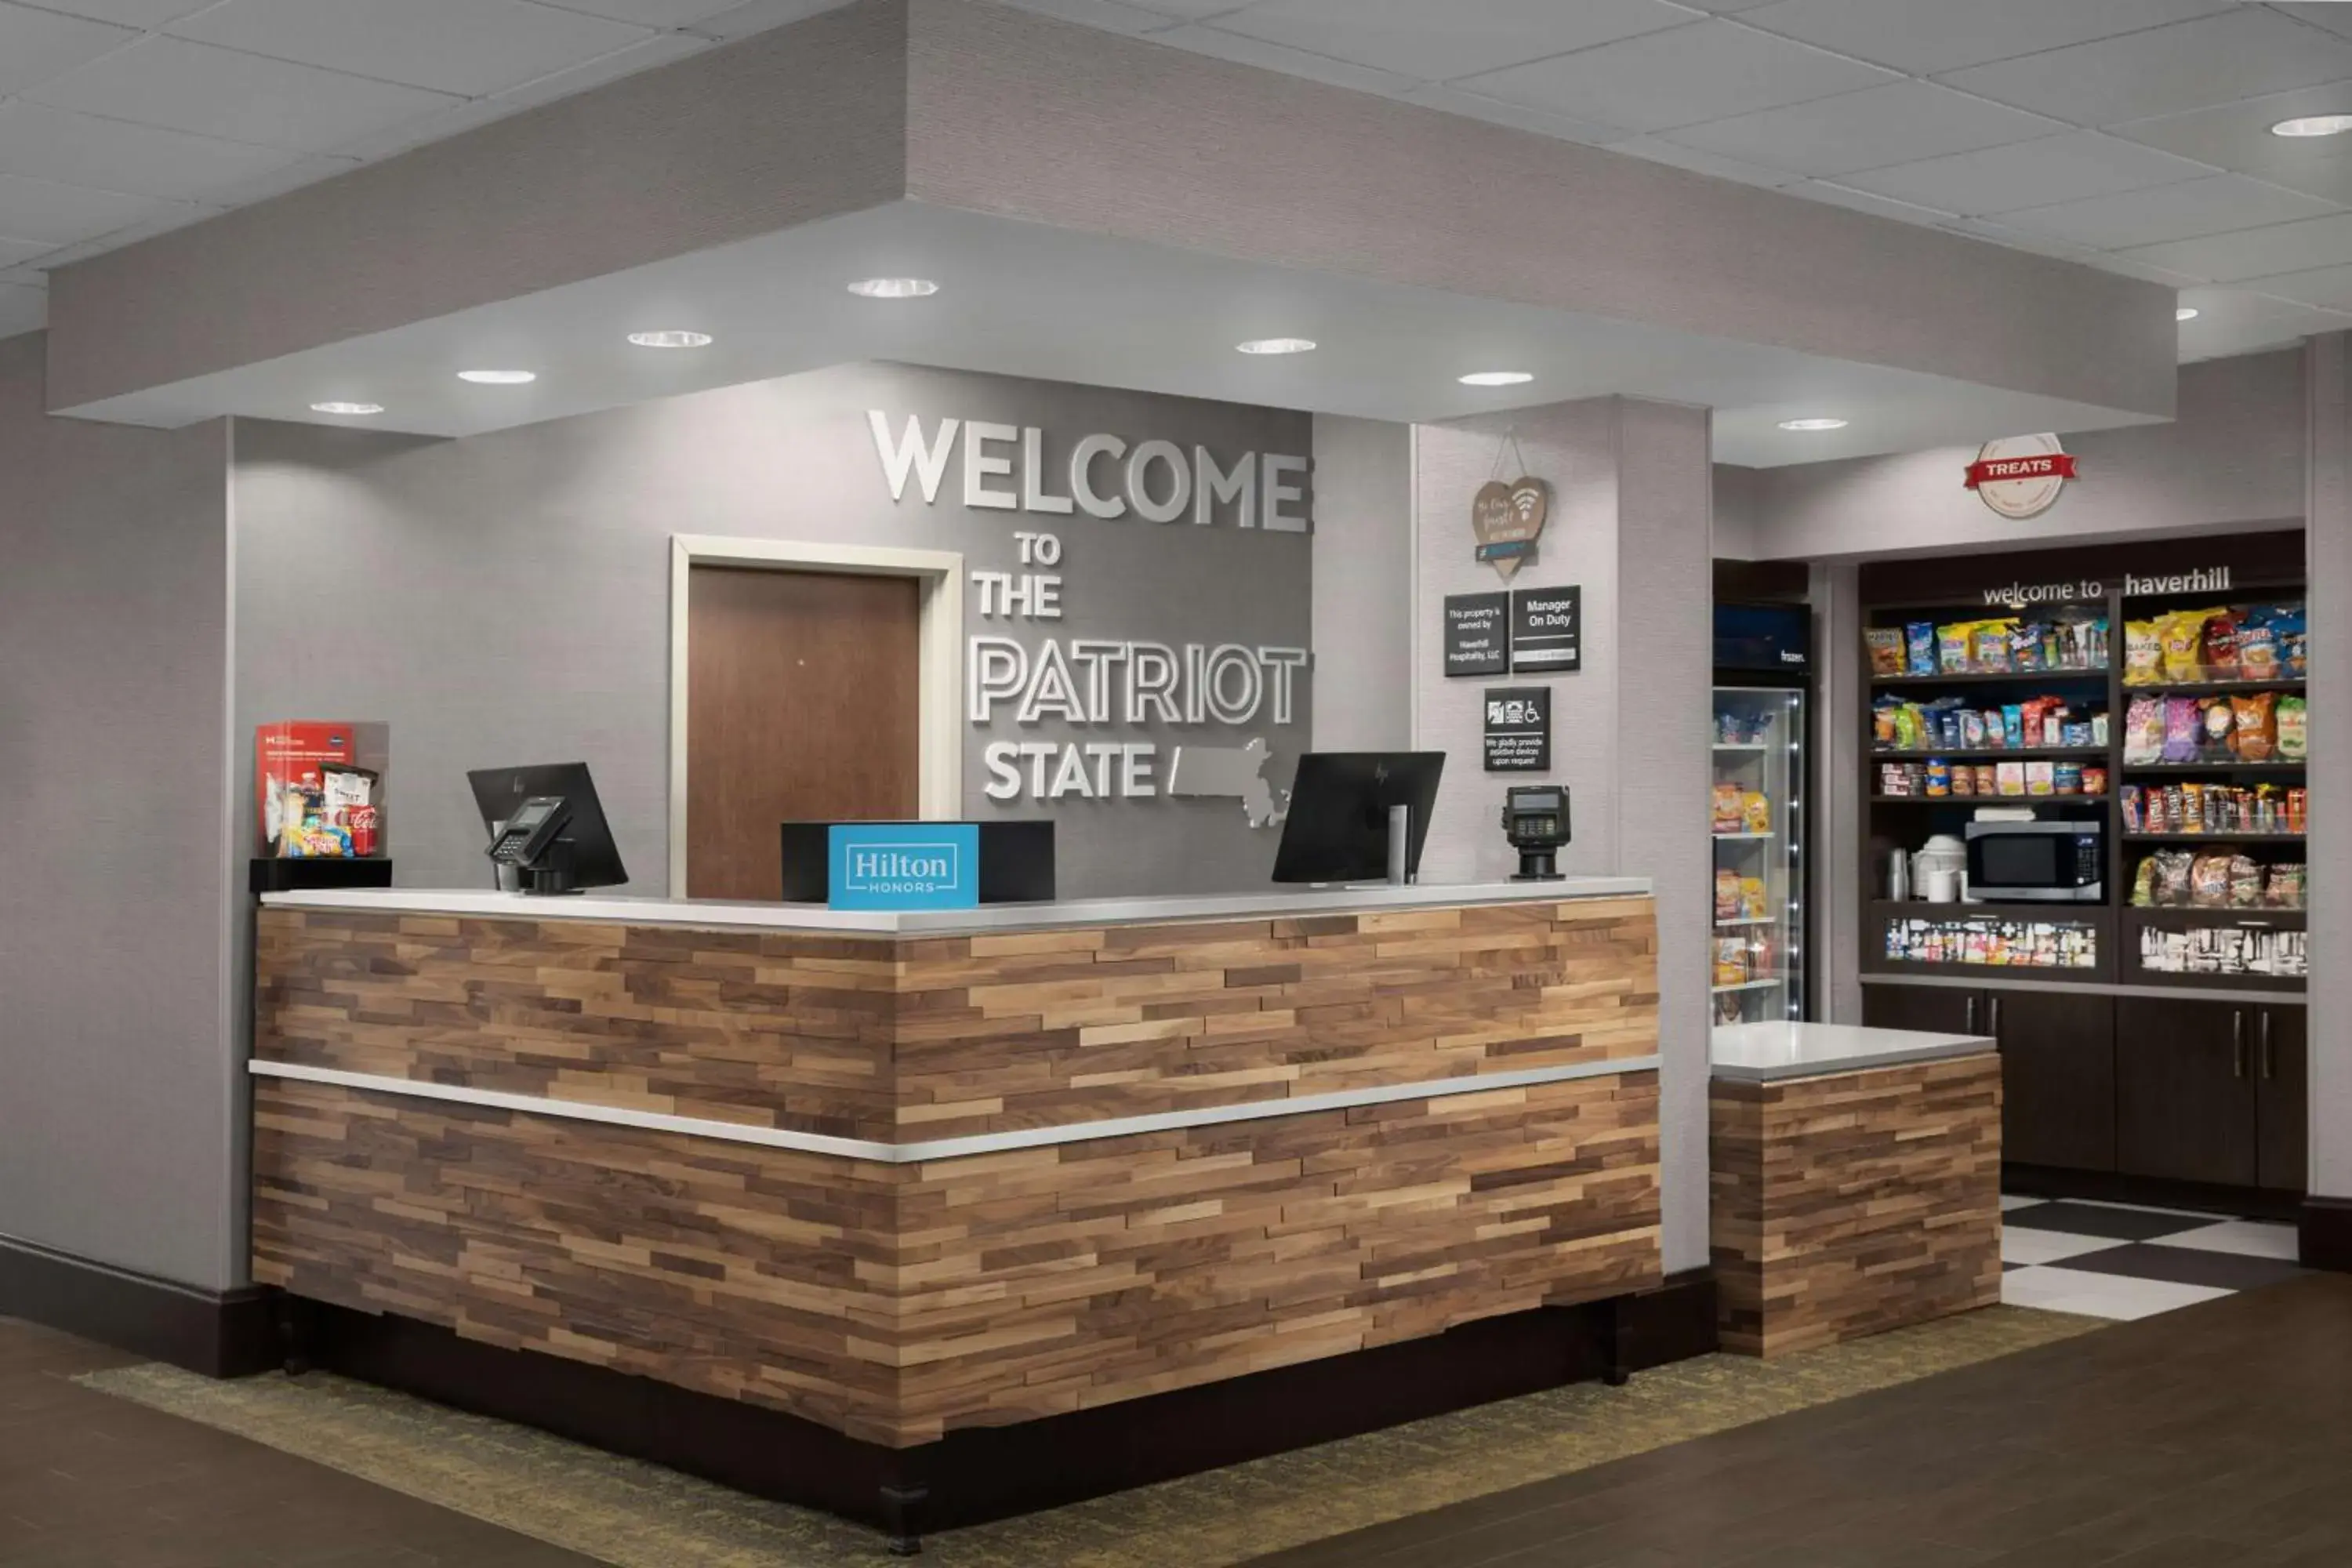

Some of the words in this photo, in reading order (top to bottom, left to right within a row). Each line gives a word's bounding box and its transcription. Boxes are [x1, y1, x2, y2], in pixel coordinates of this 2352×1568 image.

[867, 408, 1312, 533] WELCOME
[1986, 459, 2053, 477] TREATS
[1014, 531, 1062, 566] TO
[971, 571, 1062, 617] THE
[1984, 582, 2074, 605] welcome
[2080, 579, 2103, 599] to
[2125, 566, 2230, 596] haverhill
[1464, 608, 1494, 620] property
[1526, 601, 1571, 613] Manager
[1483, 620, 1492, 630] by
[1529, 615, 1544, 626] On
[1546, 614, 1571, 627] Duty
[969, 634, 1312, 725] PATRIOT
[984, 742, 1156, 799] STATE
[855, 853, 948, 878] Hilton
[869, 882, 935, 894] HONORS
